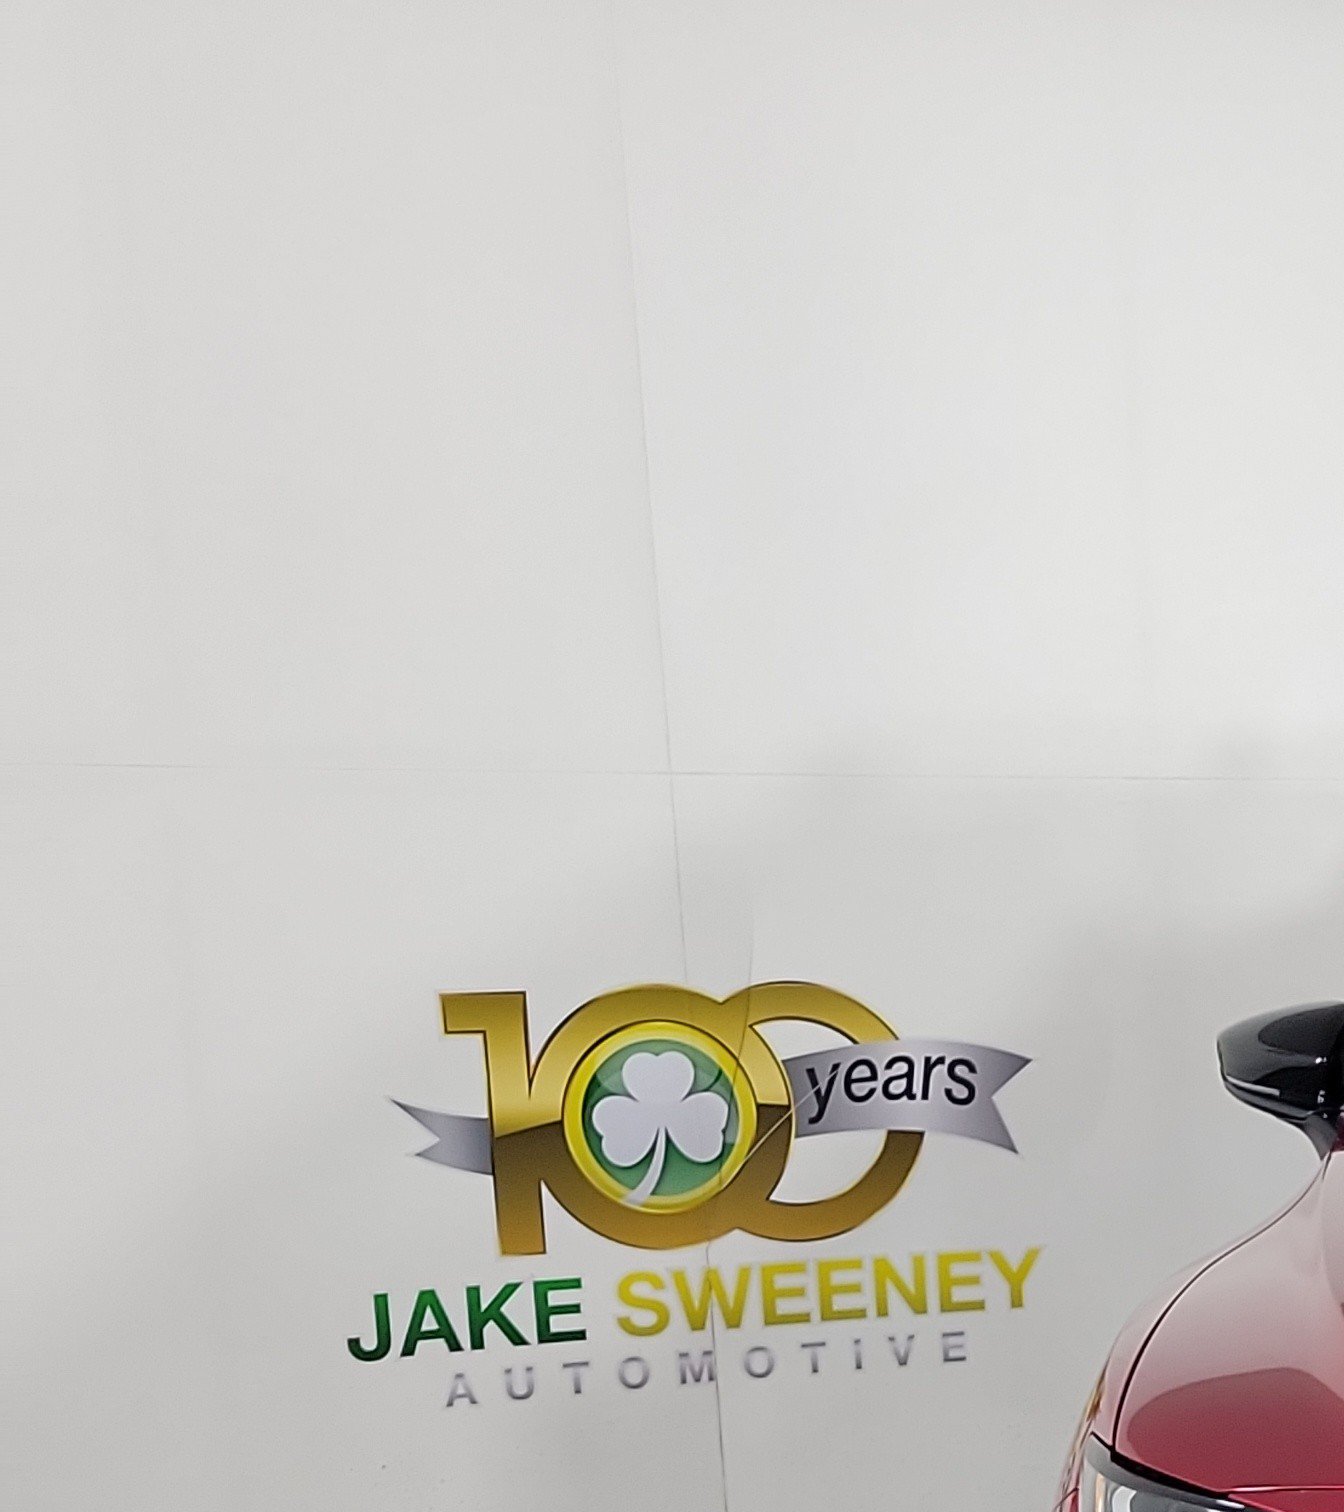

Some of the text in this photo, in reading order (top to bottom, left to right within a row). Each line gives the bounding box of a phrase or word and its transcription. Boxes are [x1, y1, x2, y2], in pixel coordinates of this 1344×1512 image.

[805, 1051, 978, 1126] years
[346, 1247, 1042, 1362] JAKE SWEENEY
[445, 1331, 967, 1408] AUTOMOTIVE
